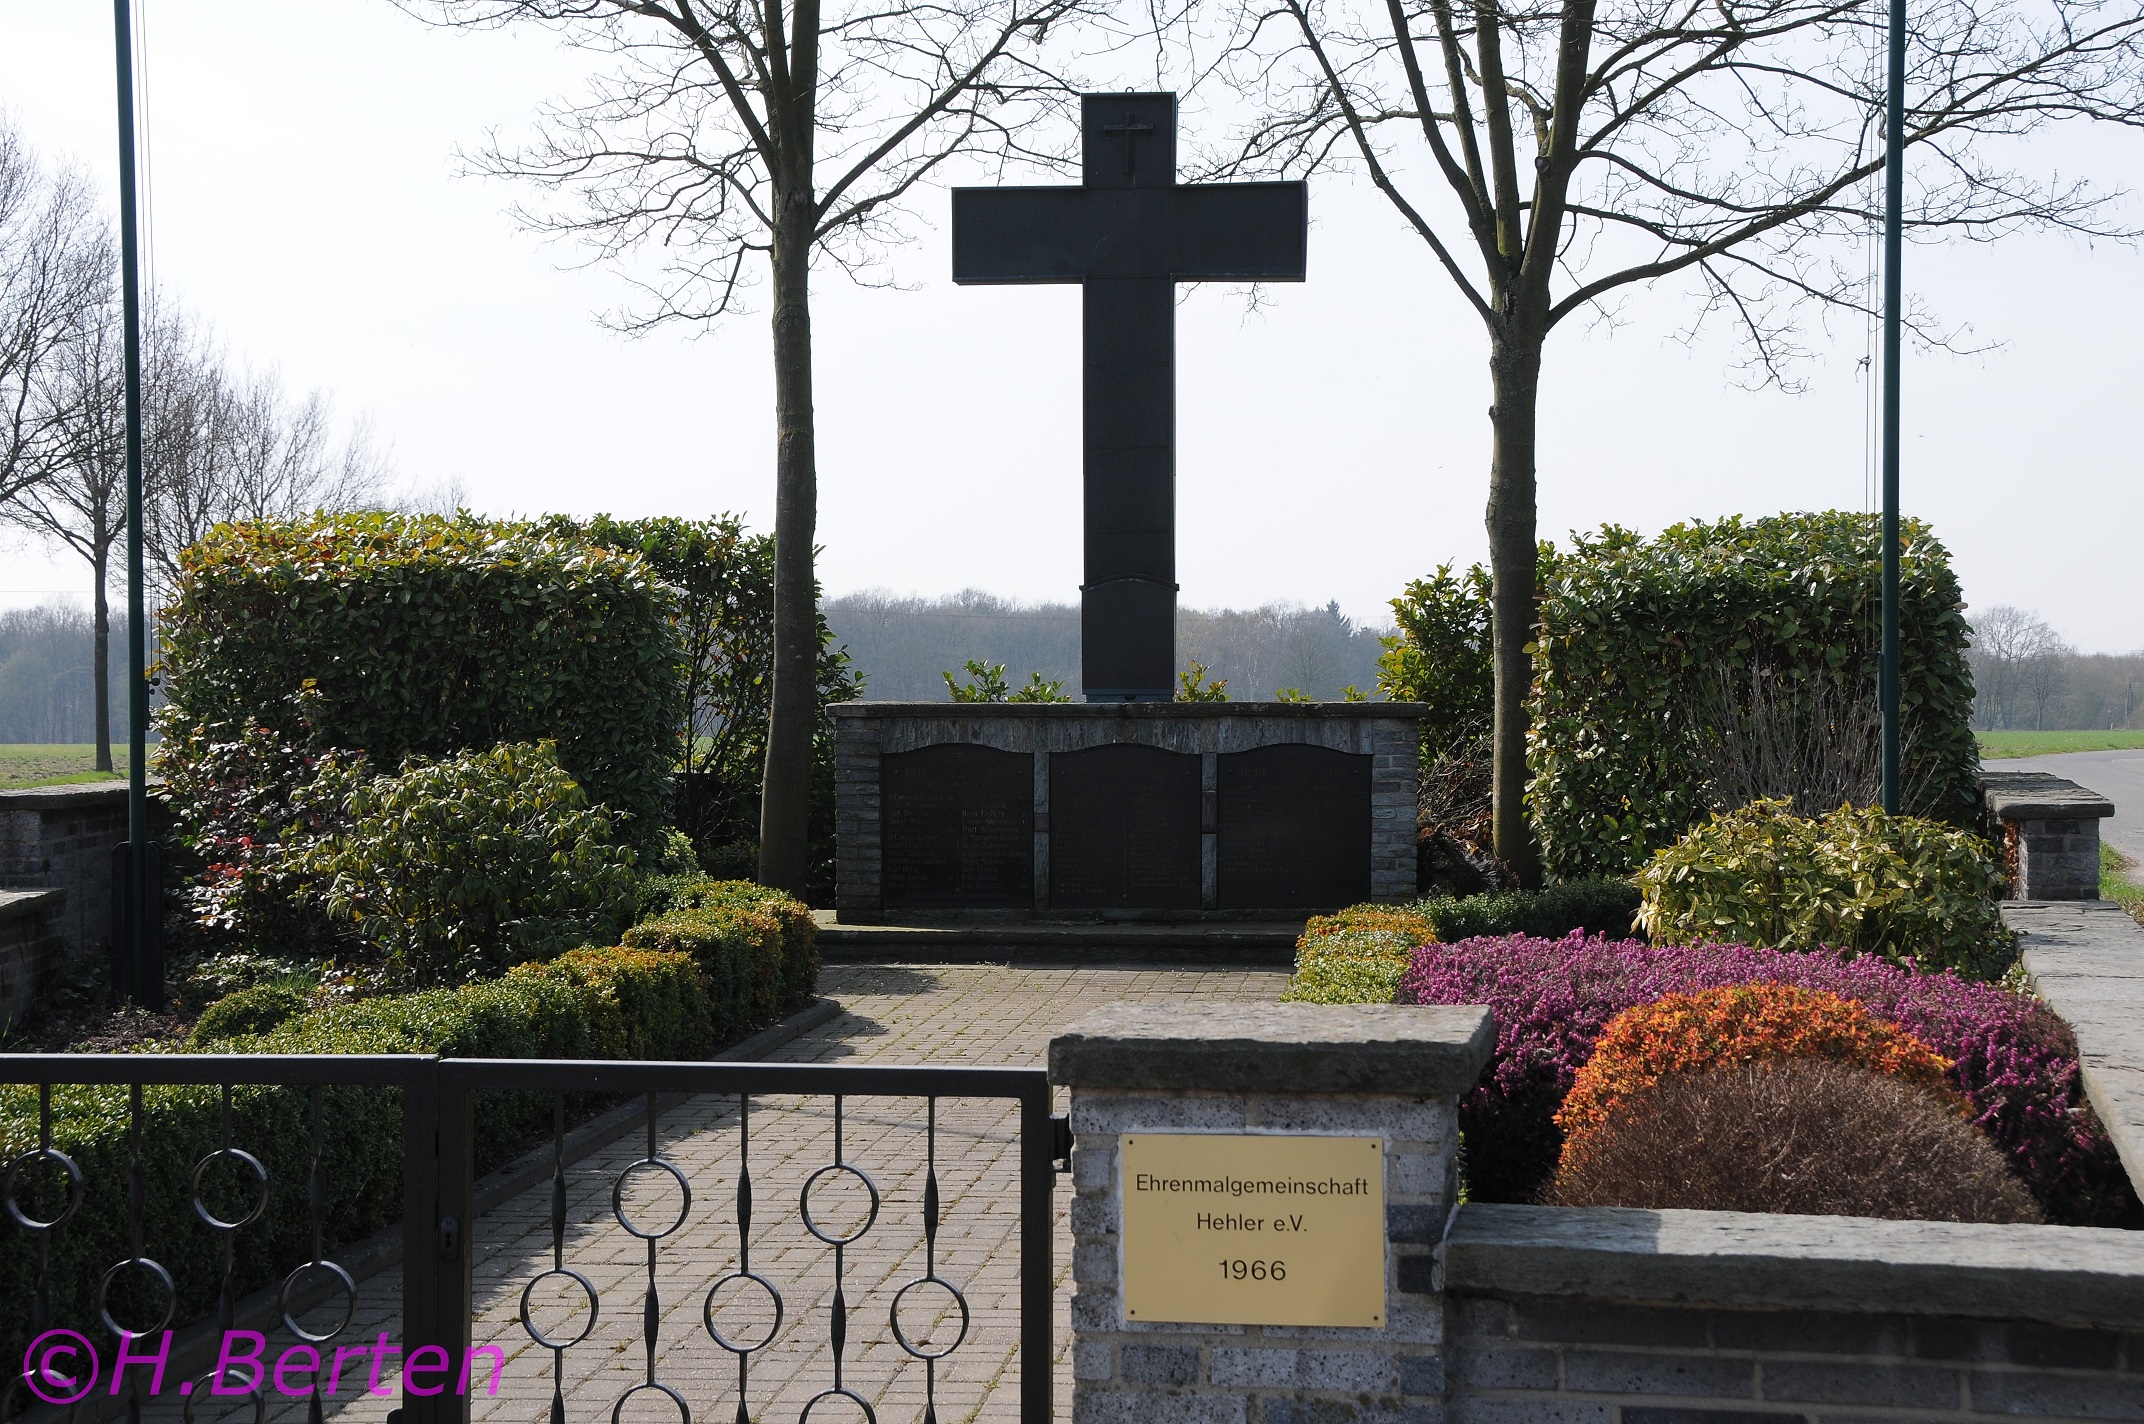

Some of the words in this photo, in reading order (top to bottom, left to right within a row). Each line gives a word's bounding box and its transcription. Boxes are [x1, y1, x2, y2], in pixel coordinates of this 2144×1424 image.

[1136, 1174, 1369, 1196] Ehrenmalgemeinschaft
[1197, 1213, 1265, 1231] Hehler
[1273, 1214, 1307, 1232] e.V.
[1219, 1260, 1287, 1281] 1966
